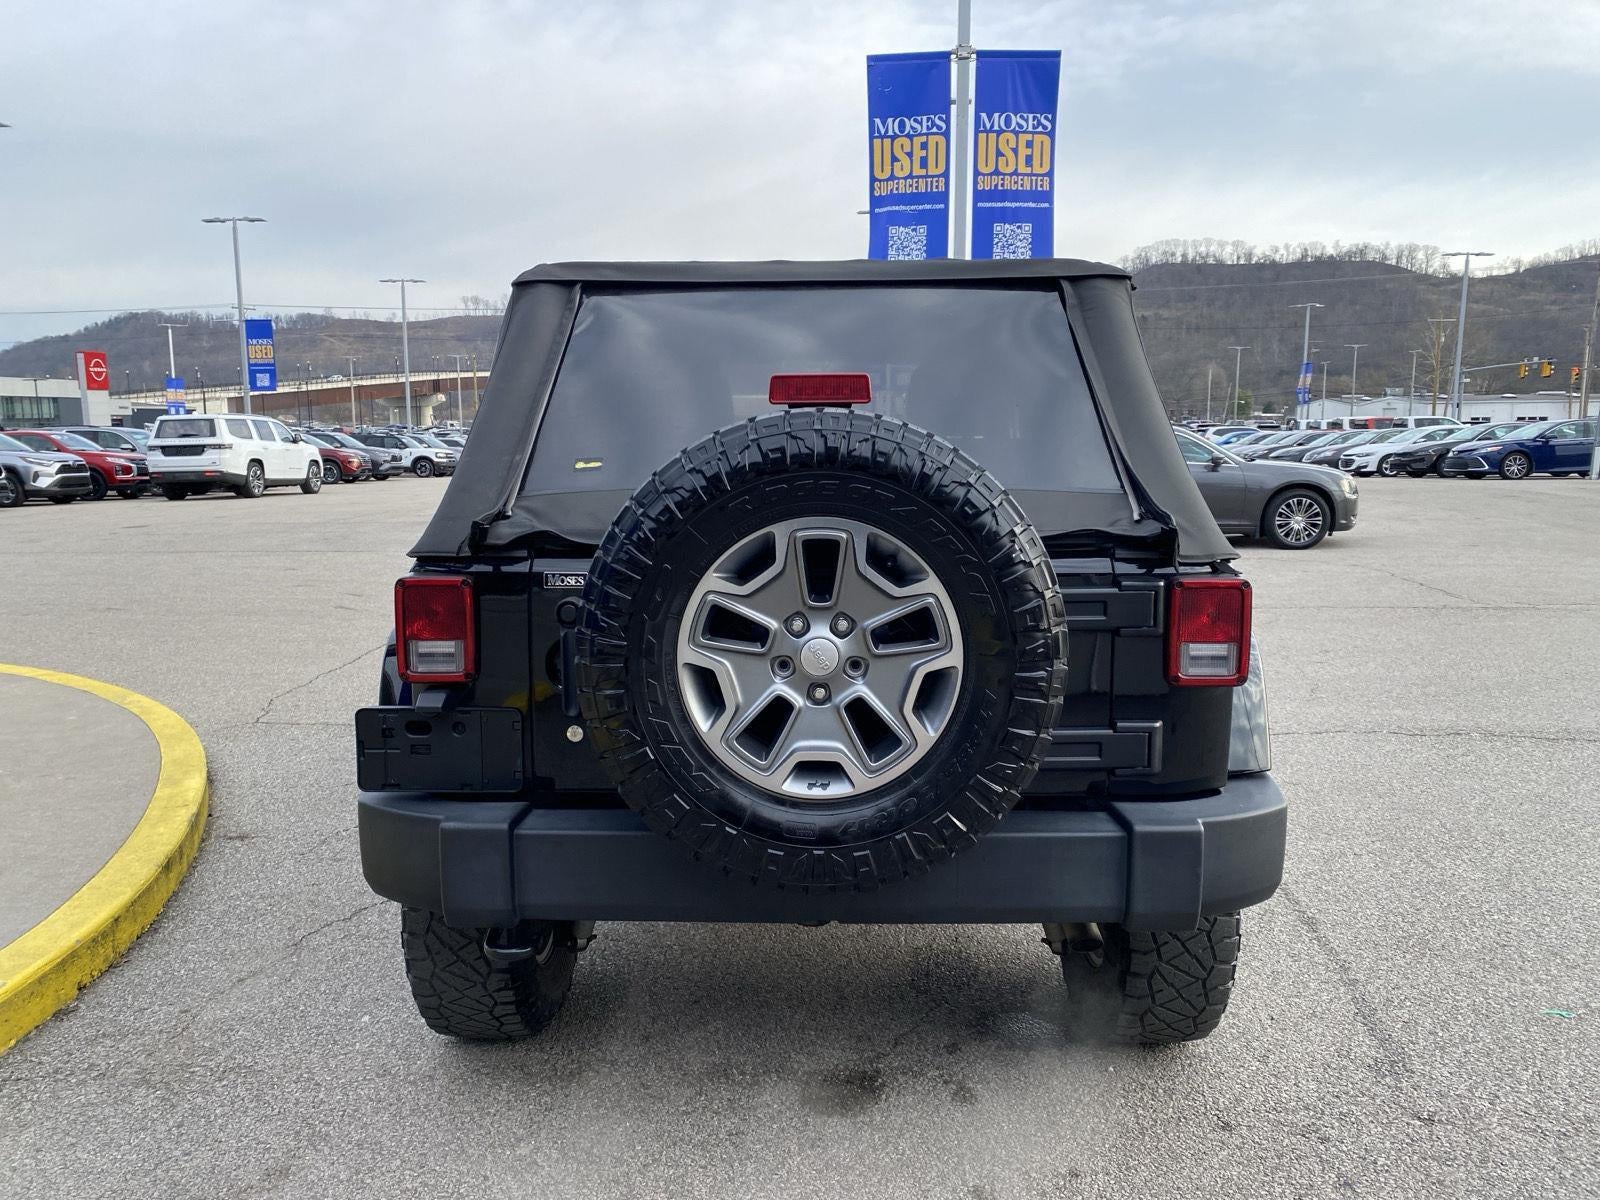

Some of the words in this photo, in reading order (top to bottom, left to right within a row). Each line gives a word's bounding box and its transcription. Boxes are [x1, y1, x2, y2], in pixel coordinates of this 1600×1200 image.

[873, 114, 947, 136] MOSES
[979, 112, 1052, 132] MOSES
[873, 135, 946, 180] USED
[977, 132, 1051, 174] USED
[874, 177, 945, 196] SUPERCENTER
[977, 175, 1050, 191] SUPERCENTER
[977, 201, 1050, 209] mosesusedsupercenter.com
[248, 345, 273, 359] USED
[547, 574, 585, 586] MOSES
[810, 642, 831, 670] Jeep
